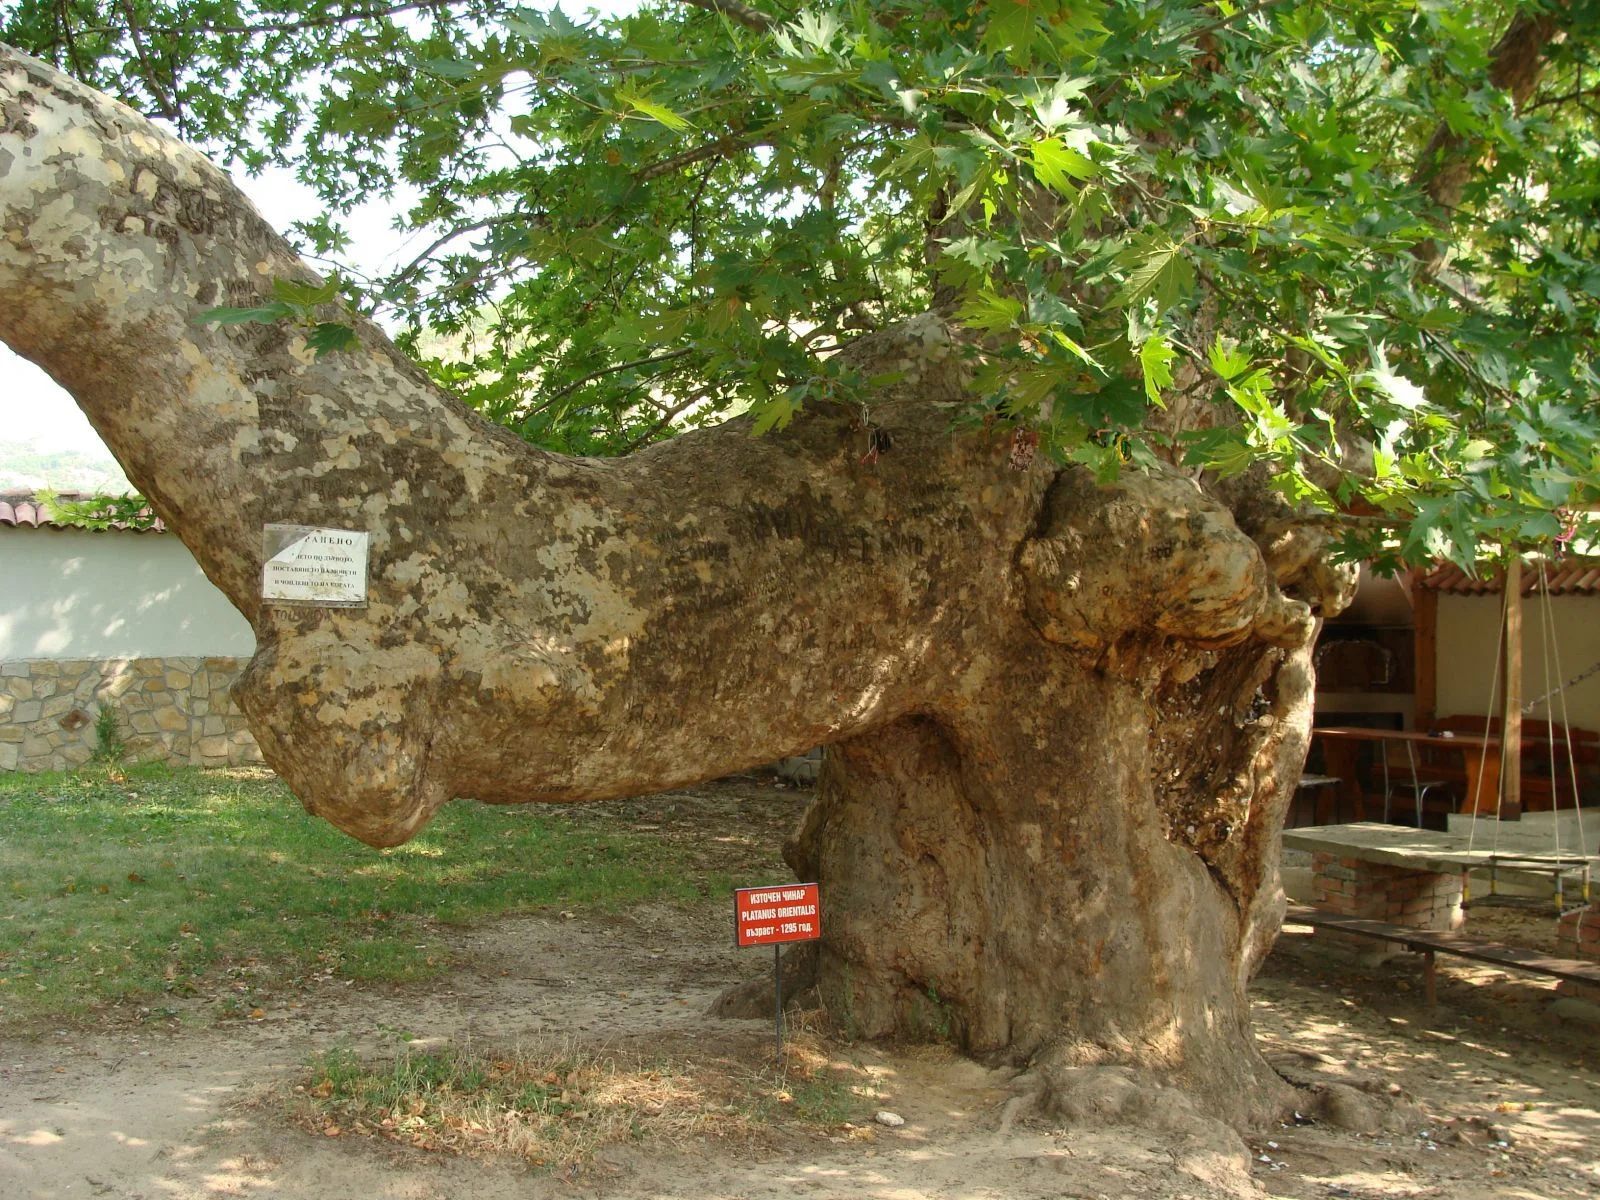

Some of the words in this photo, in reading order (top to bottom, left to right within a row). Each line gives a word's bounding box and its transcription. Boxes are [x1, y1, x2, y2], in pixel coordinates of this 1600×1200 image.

[304, 536, 353, 545] РАНЕНО
[751, 892, 781, 904] ИЗТОЧЕН
[782, 890, 805, 901] ЧИНАР
[742, 909, 776, 921] PLATANUS
[777, 905, 816, 918] ORIENTALIS
[746, 927, 774, 937] възраст
[780, 923, 797, 934] 1295
[798, 923, 814, 933] год.
